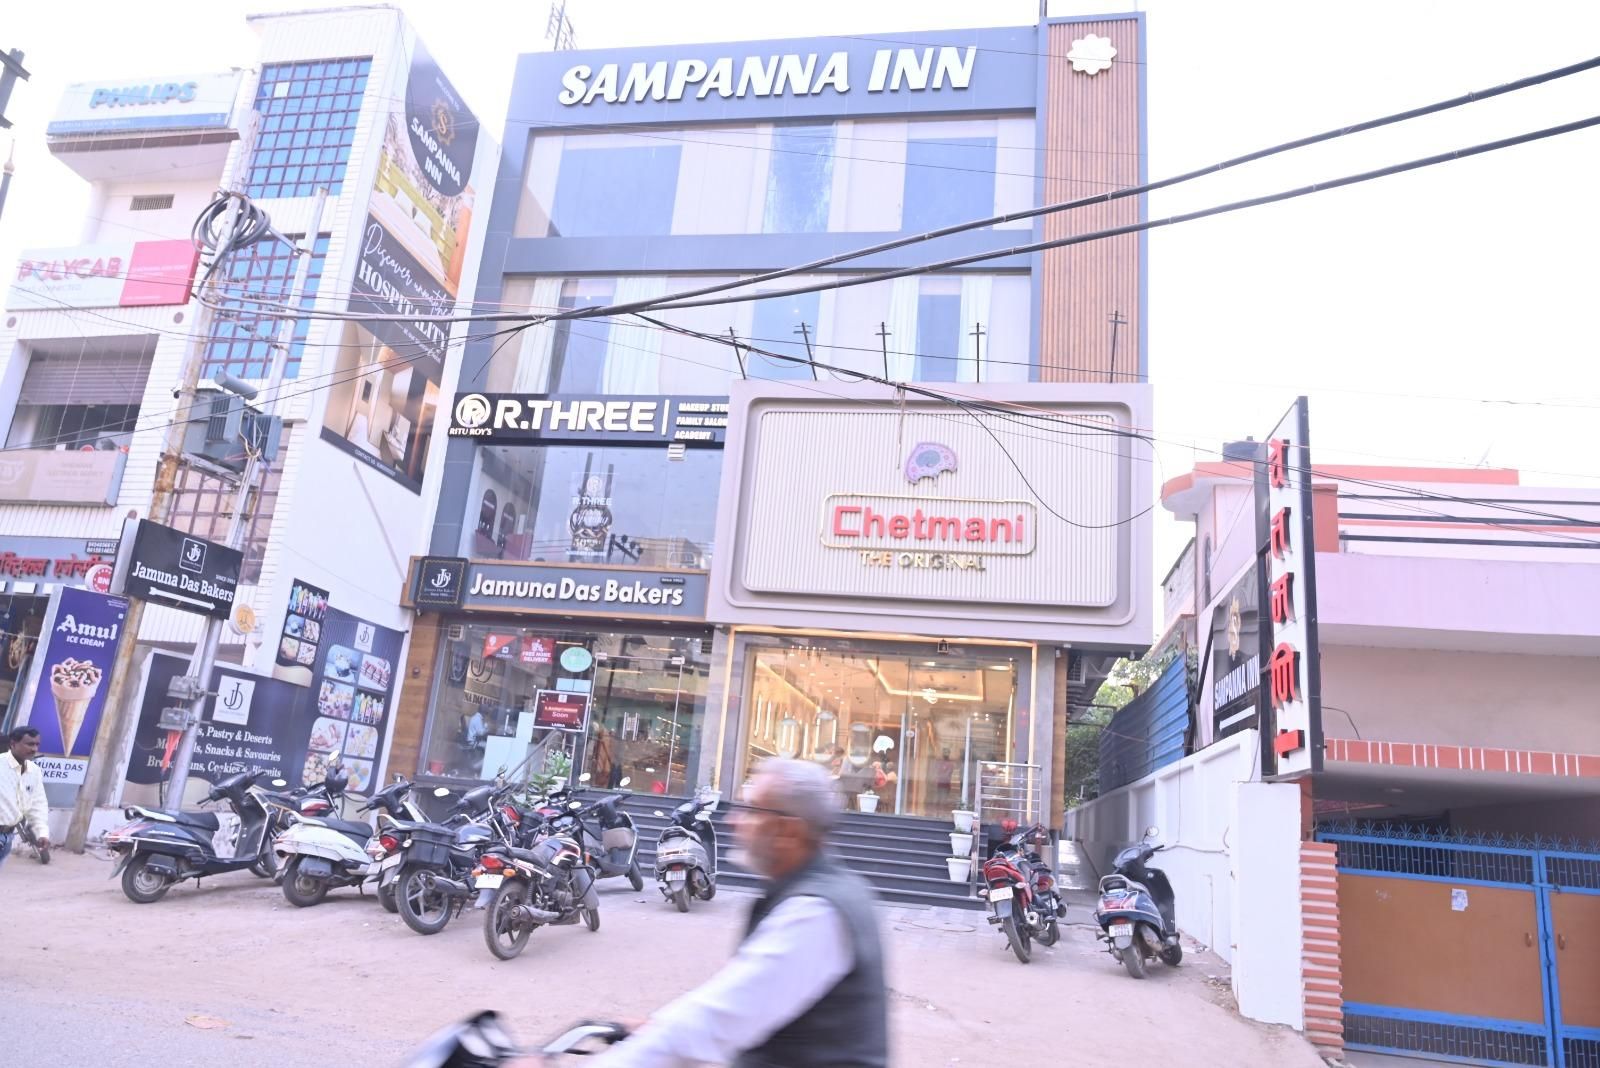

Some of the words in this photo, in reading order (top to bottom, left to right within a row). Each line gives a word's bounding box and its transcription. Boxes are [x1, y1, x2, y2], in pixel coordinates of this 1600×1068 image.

[559, 53, 850, 107] SAMPANNA
[867, 45, 978, 92] INN
[89, 81, 199, 109] PHILIPS
[411, 117, 461, 187] SAMPANNA
[425, 156, 442, 186] INN
[363, 223, 413, 286] Discover
[358, 259, 446, 349] HOSPITALITY
[494, 400, 657, 432] R.THREE
[676, 416, 703, 425] FAMILY
[449, 427, 468, 435] RITU
[469, 427, 492, 436] ROY'S
[674, 430, 711, 440] ACADEMY
[833, 505, 1025, 543] Chetmani
[860, 551, 892, 568] THE
[897, 552, 987, 572] ORIGINAL
[132, 561, 178, 587] Jamuna
[179, 574, 200, 593] Das
[200, 580, 234, 602] Bakers
[469, 573, 557, 600] Jamuna
[559, 578, 600, 602] Das
[604, 579, 684, 606] Bakers
[57, 614, 118, 641] Amul
[66, 635, 78, 645] ICE
[79, 637, 105, 648] CREAM
[206, 726, 235, 742] Pastry
[235, 730, 243, 741] &
[243, 731, 273, 745] Deserts
[34, 761, 61, 770] MUNA
[64, 763, 84, 771] DAS
[205, 743, 235, 757] Snacks
[235, 747, 243, 757] &
[244, 748, 281, 762] Savouries
[43, 770, 69, 779] KERS
